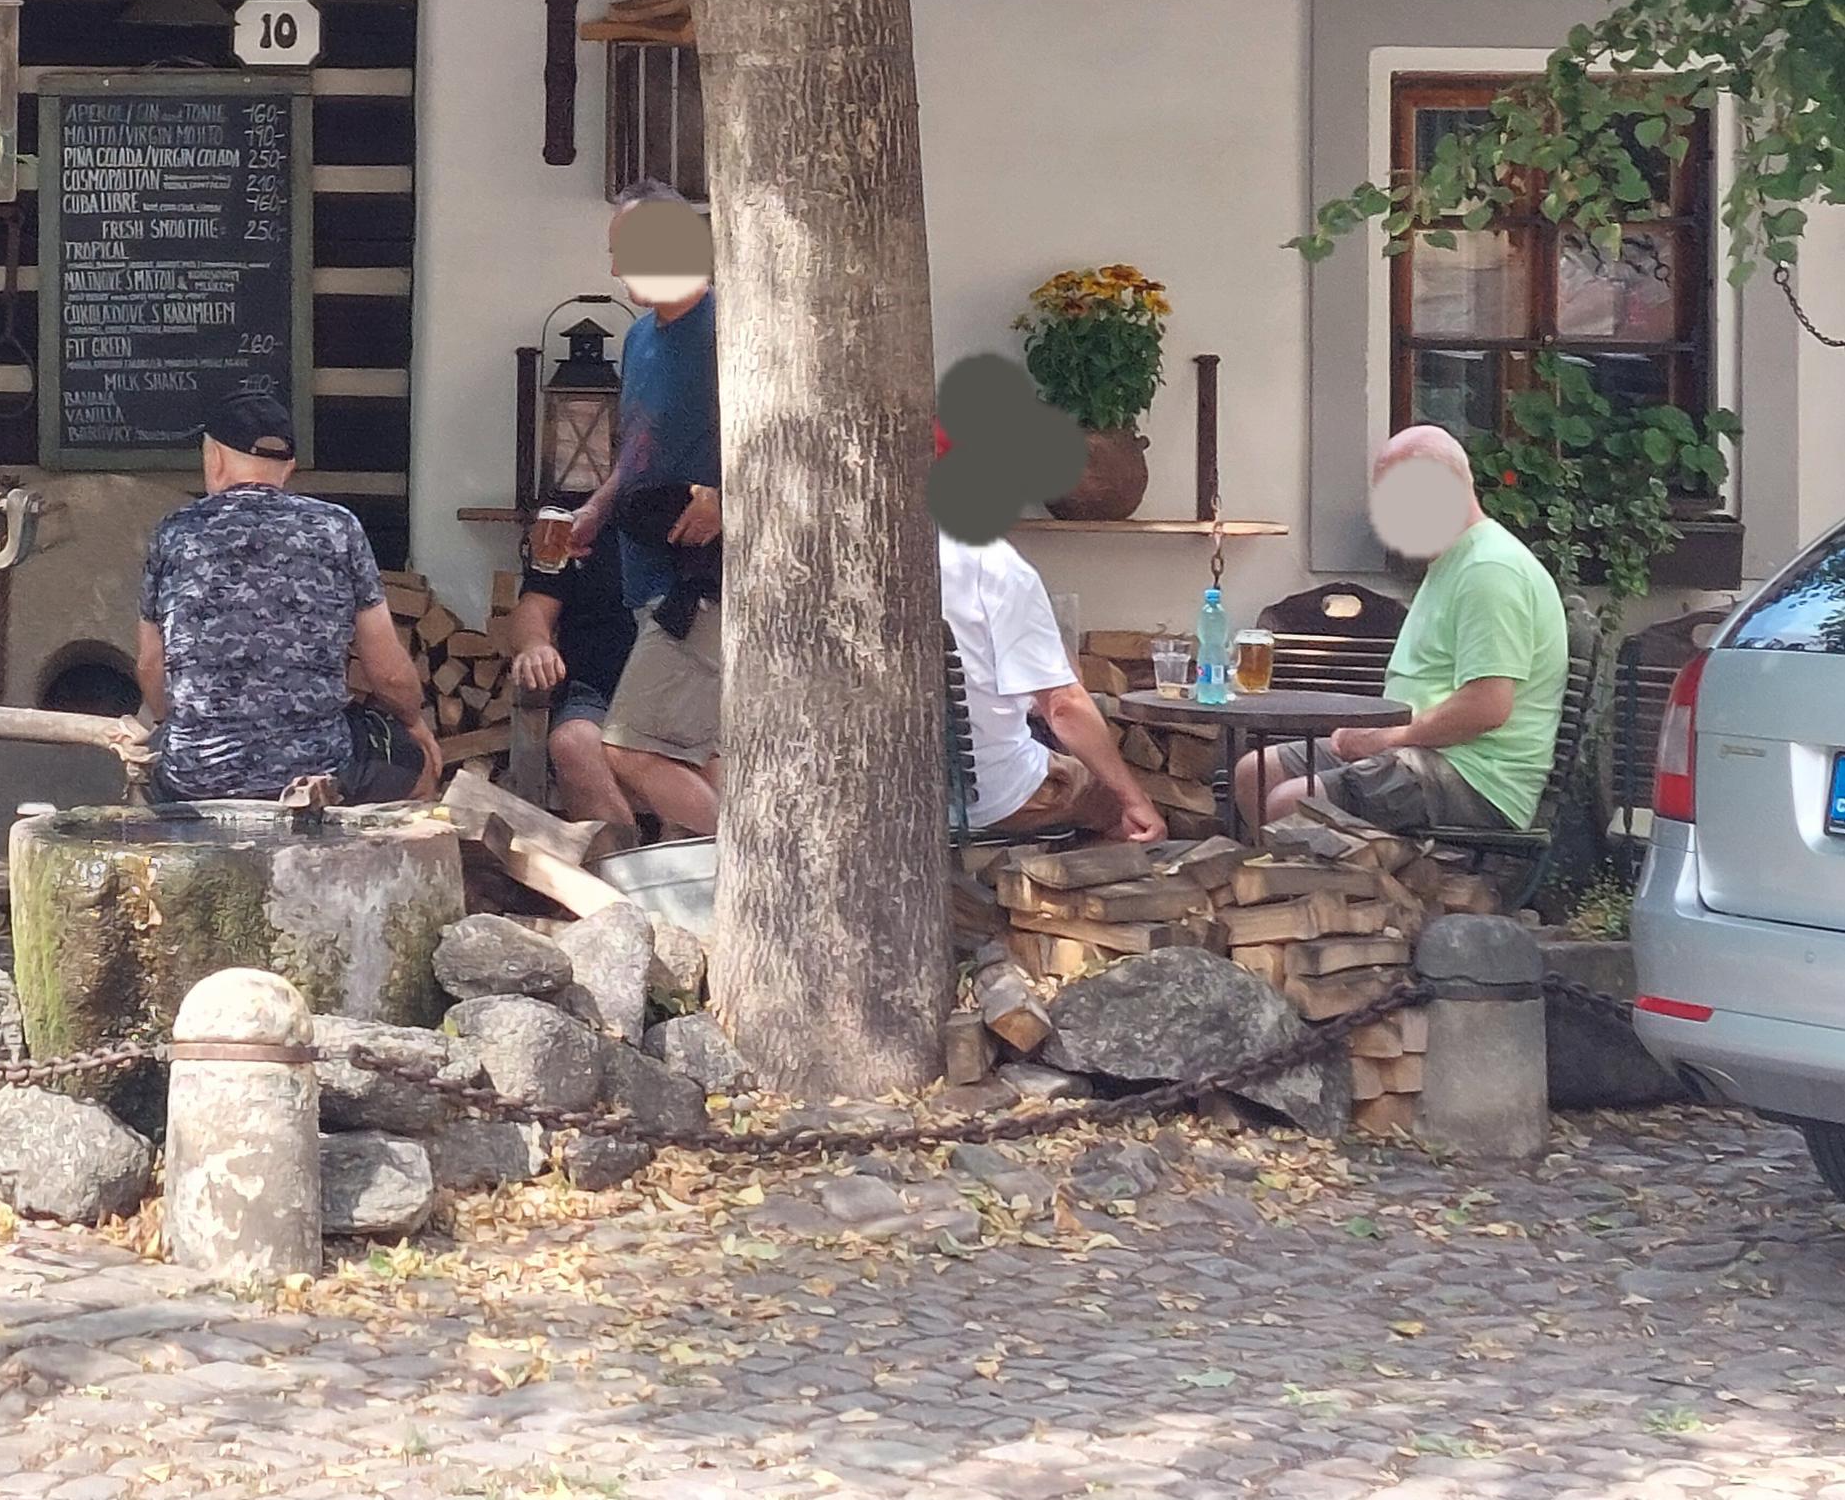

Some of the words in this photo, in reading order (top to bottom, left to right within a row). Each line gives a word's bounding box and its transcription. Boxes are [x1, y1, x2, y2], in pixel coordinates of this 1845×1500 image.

[259, 12, 298, 49] 10
[176, 124, 223, 146] MOJITO
[197, 148, 240, 168] COLADA
[248, 149, 287, 170] 250,-
[63, 169, 162, 192] COSMOPOLITAN
[63, 194, 99, 214] CUBA
[100, 192, 140, 213] LIBRE
[102, 220, 144, 239] FRESH
[65, 242, 129, 260] TROPICAL
[163, 302, 236, 325] KARAMELEM
[66, 338, 88, 358] FIT
[91, 338, 132, 358] GREEN
[105, 373, 141, 391] MILK
[144, 372, 197, 390] SHAKES
[64, 391, 116, 406] BANANA
[65, 406, 124, 423] VANILLA
